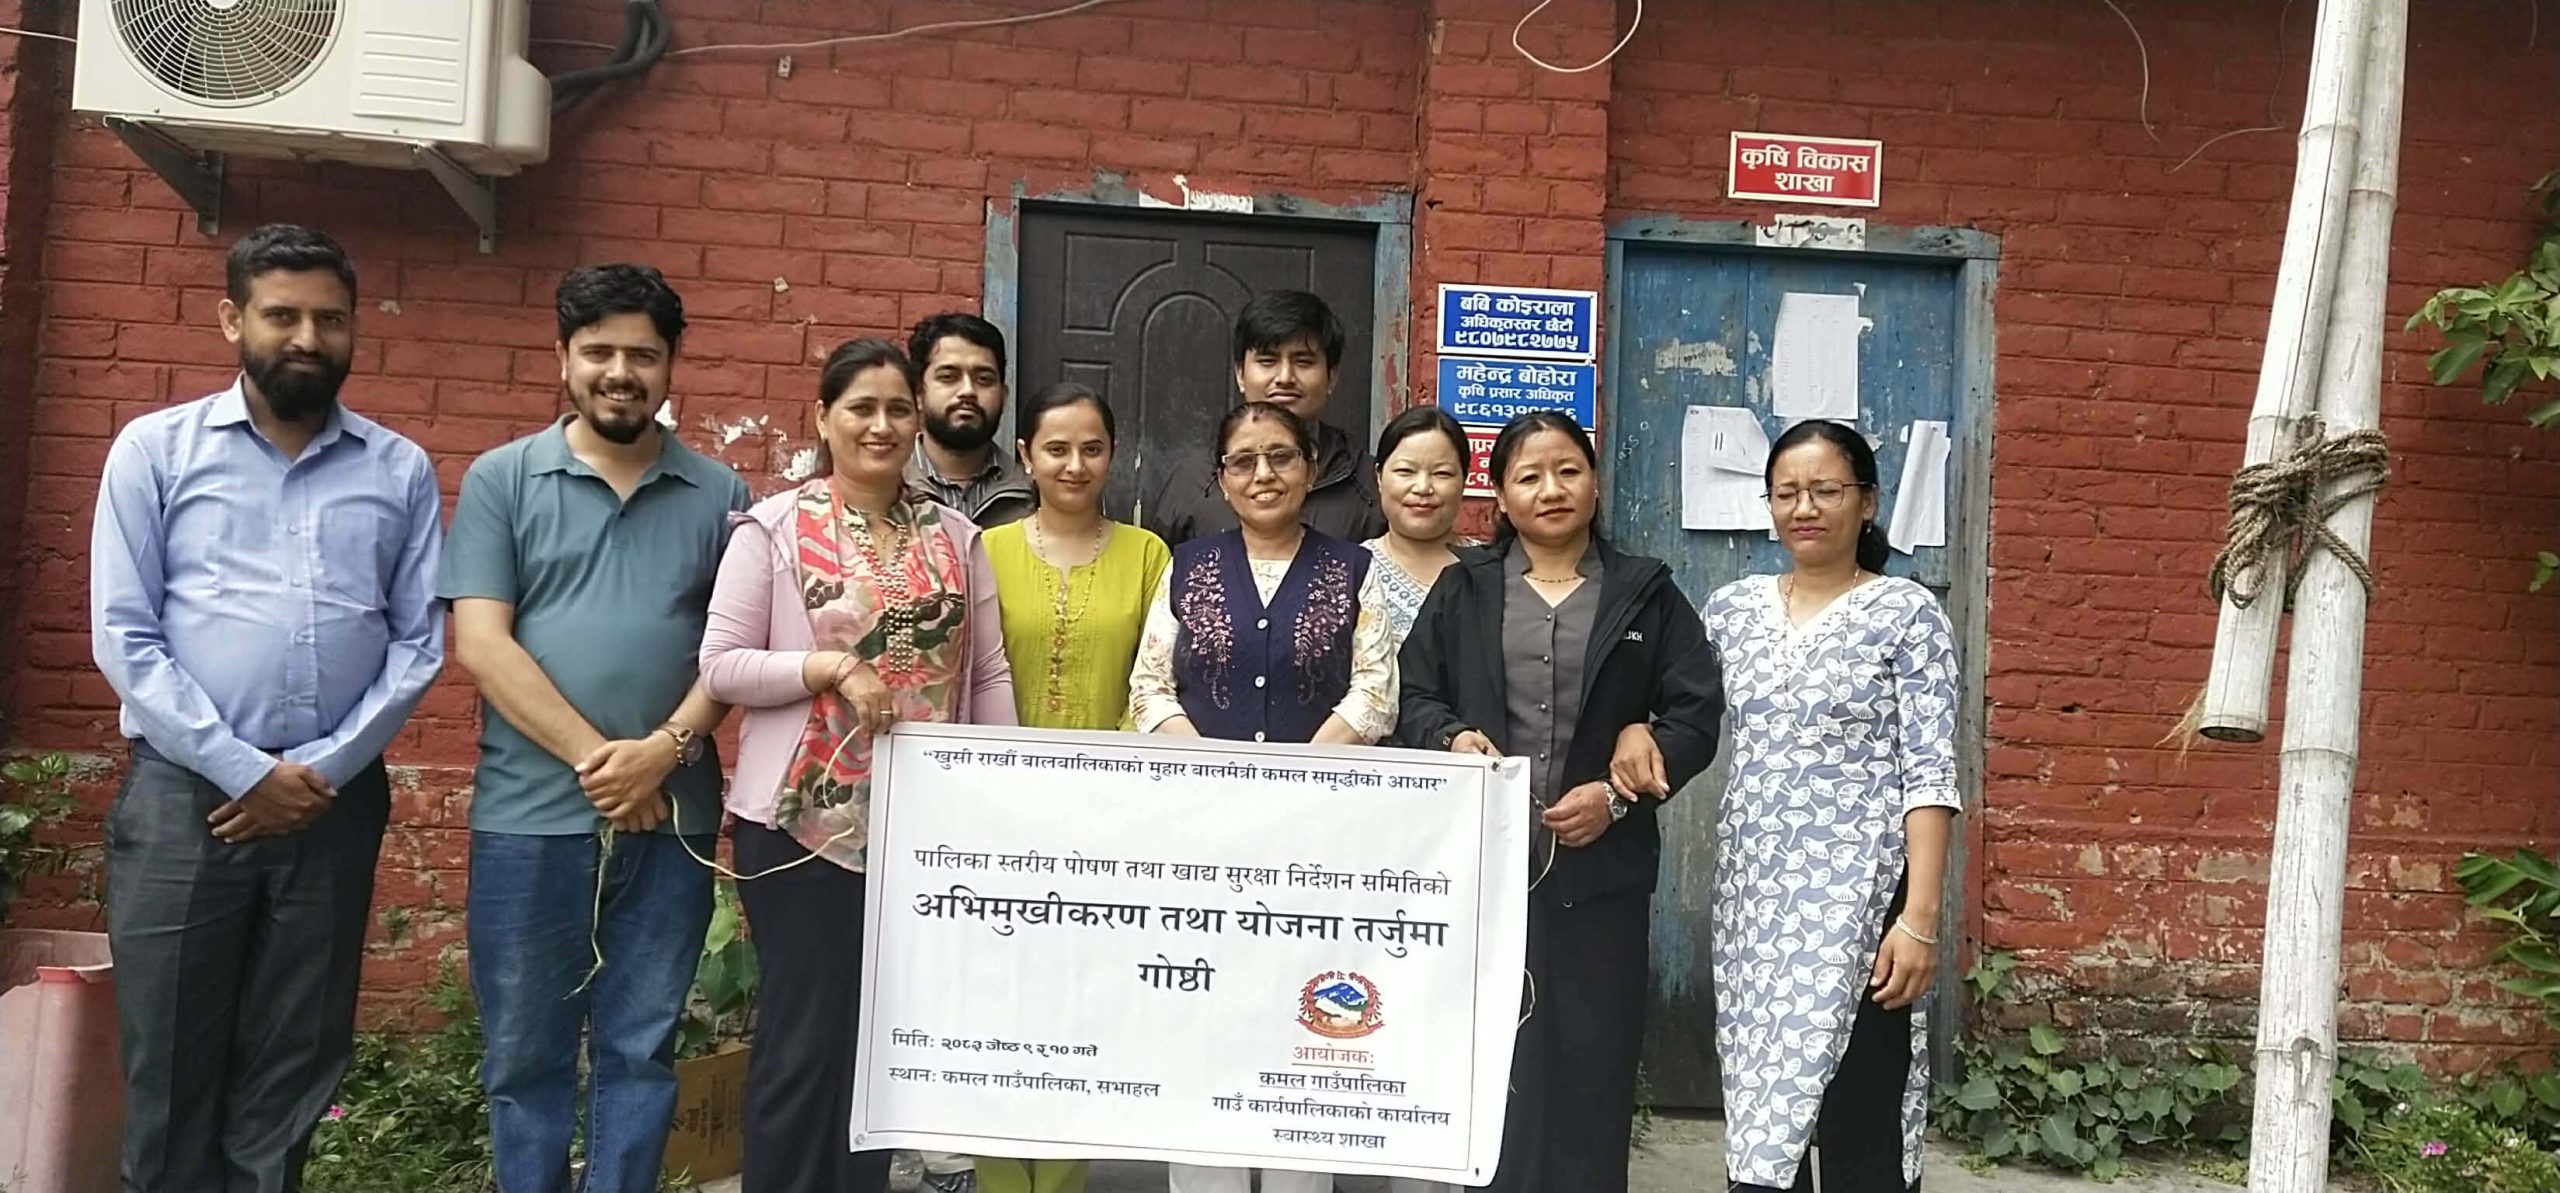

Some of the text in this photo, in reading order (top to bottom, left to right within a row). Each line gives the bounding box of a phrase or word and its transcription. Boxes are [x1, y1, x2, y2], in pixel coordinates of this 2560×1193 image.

[1740, 144, 1871, 173] कृषि विकास
[1774, 172, 1835, 193] शाखा
[1495, 295, 1576, 317] कोइराला
[1456, 362, 1578, 386] महेन्द्र बोहोरा
[1458, 383, 1576, 404] कृषि प्रसार अधिकृत
[1148, 762, 1187, 781] मुहार
[1261, 768, 1308, 782] कमल
[913, 844, 992, 870] पालिका
[997, 850, 1058, 873] स्तरीय
[1064, 850, 1119, 876] पोषण
[1124, 861, 1166, 879] तथा
[1171, 864, 1220, 882] खाद्य
[1224, 866, 1280, 893] सुरक्षा
[1360, 869, 1452, 895] समितिको
[912, 885, 1450, 958] अभिमुखीकरण तथा योजना तर्जुमा
[1137, 953, 1216, 992] गोष्ठी
[941, 1071, 989, 1086] कमल
[1096, 1080, 1161, 1097] सभाहल
[1259, 1069, 1406, 1094] कमल गाउँपालिका
[1212, 1092, 1451, 1125] गाउँ कार्यपालिकाको कार्यालय
[1273, 1129, 1387, 1148] स्वास्थ्य शाखा
